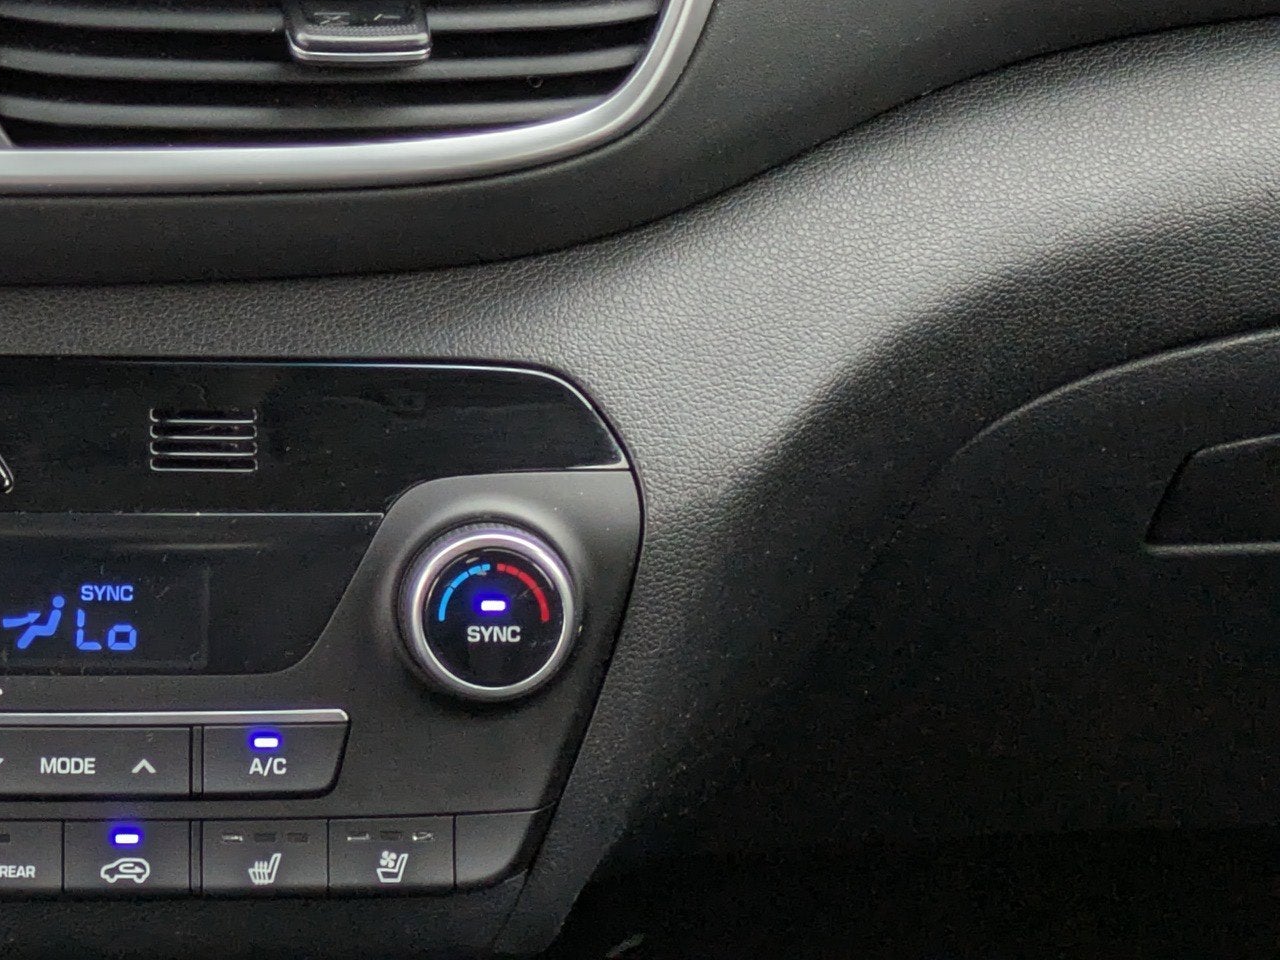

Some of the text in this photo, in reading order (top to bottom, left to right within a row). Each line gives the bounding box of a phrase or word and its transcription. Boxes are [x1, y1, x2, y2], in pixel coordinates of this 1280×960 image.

[80, 584, 134, 602] SYNC
[467, 625, 521, 643] SYNC
[40, 757, 96, 775] MODE
[249, 756, 287, 777] A/C
